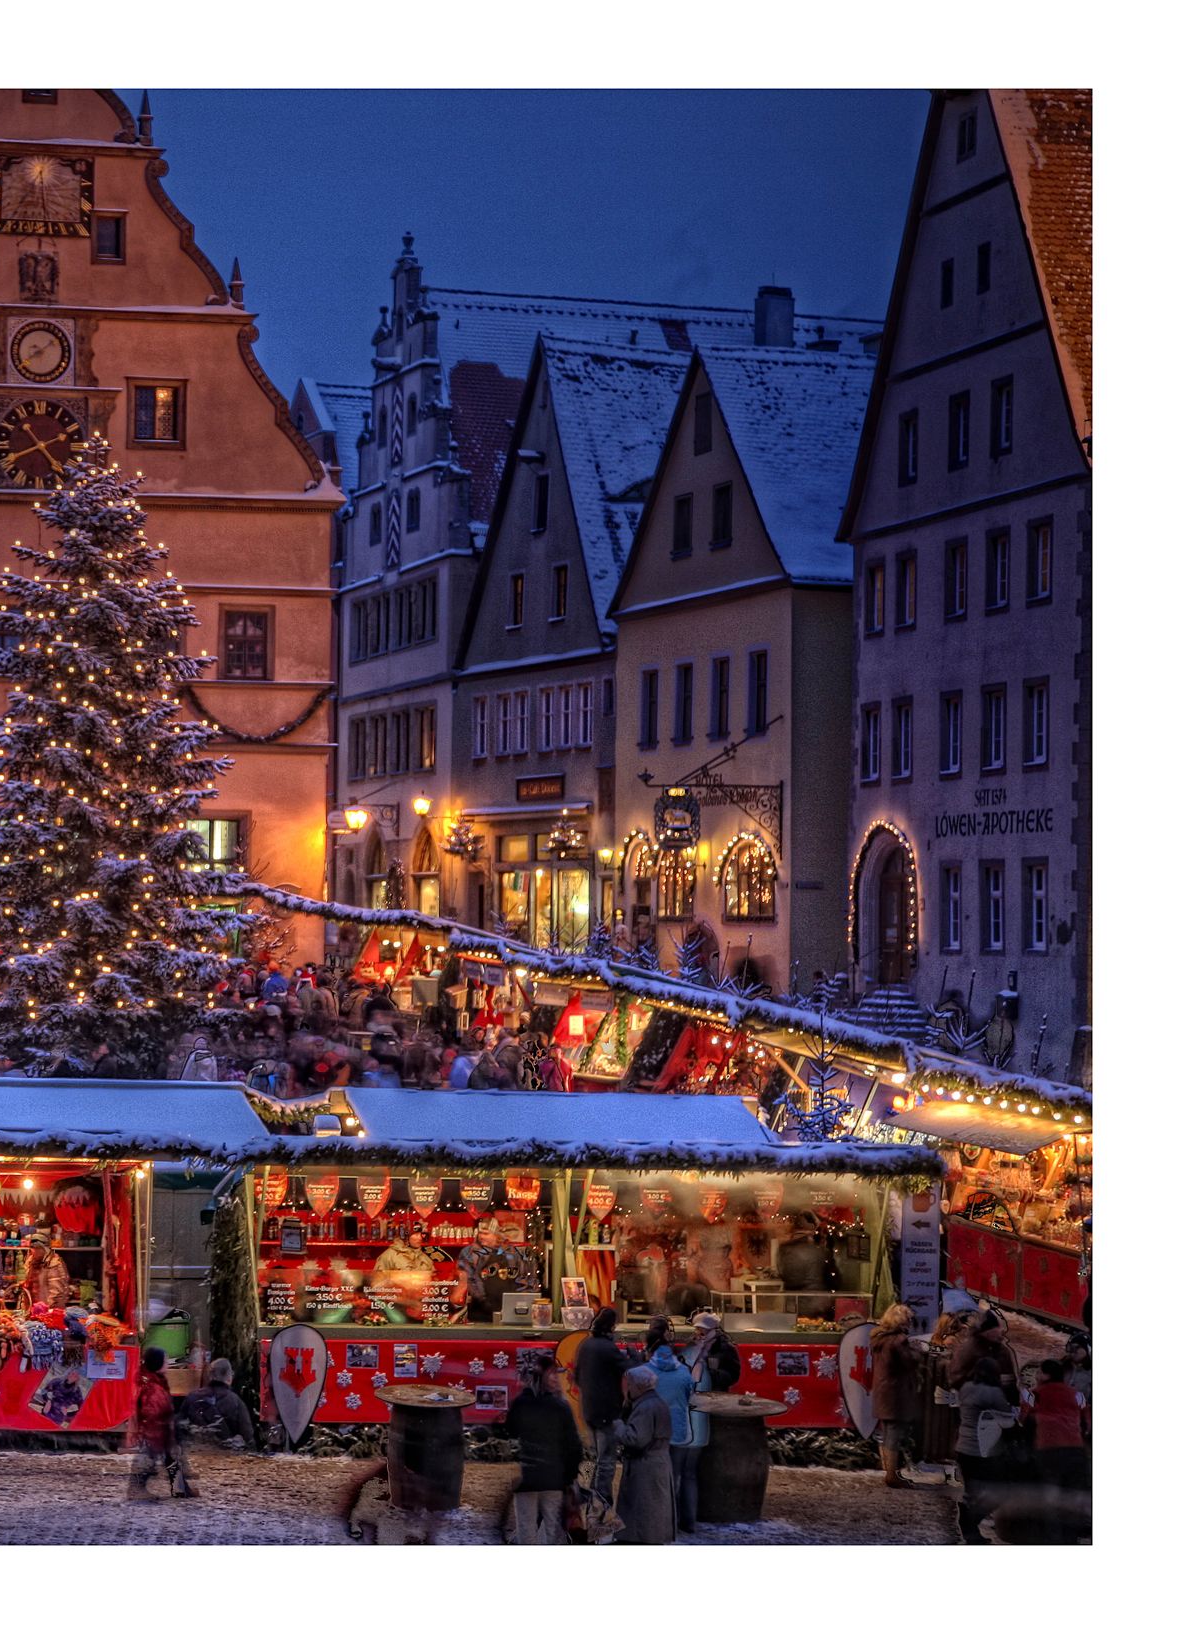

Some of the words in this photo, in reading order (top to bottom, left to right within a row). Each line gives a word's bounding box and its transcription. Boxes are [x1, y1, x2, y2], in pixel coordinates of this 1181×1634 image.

[422, 1287, 440, 1295] 3.00
[440, 1287, 449, 1295] €
[267, 1297, 286, 1305] 4.00
[286, 1297, 295, 1305] €
[335, 1293, 343, 1301] €
[387, 1301, 395, 1310] €
[422, 1304, 440, 1312] 2.00
[441, 1304, 449, 1312] €
